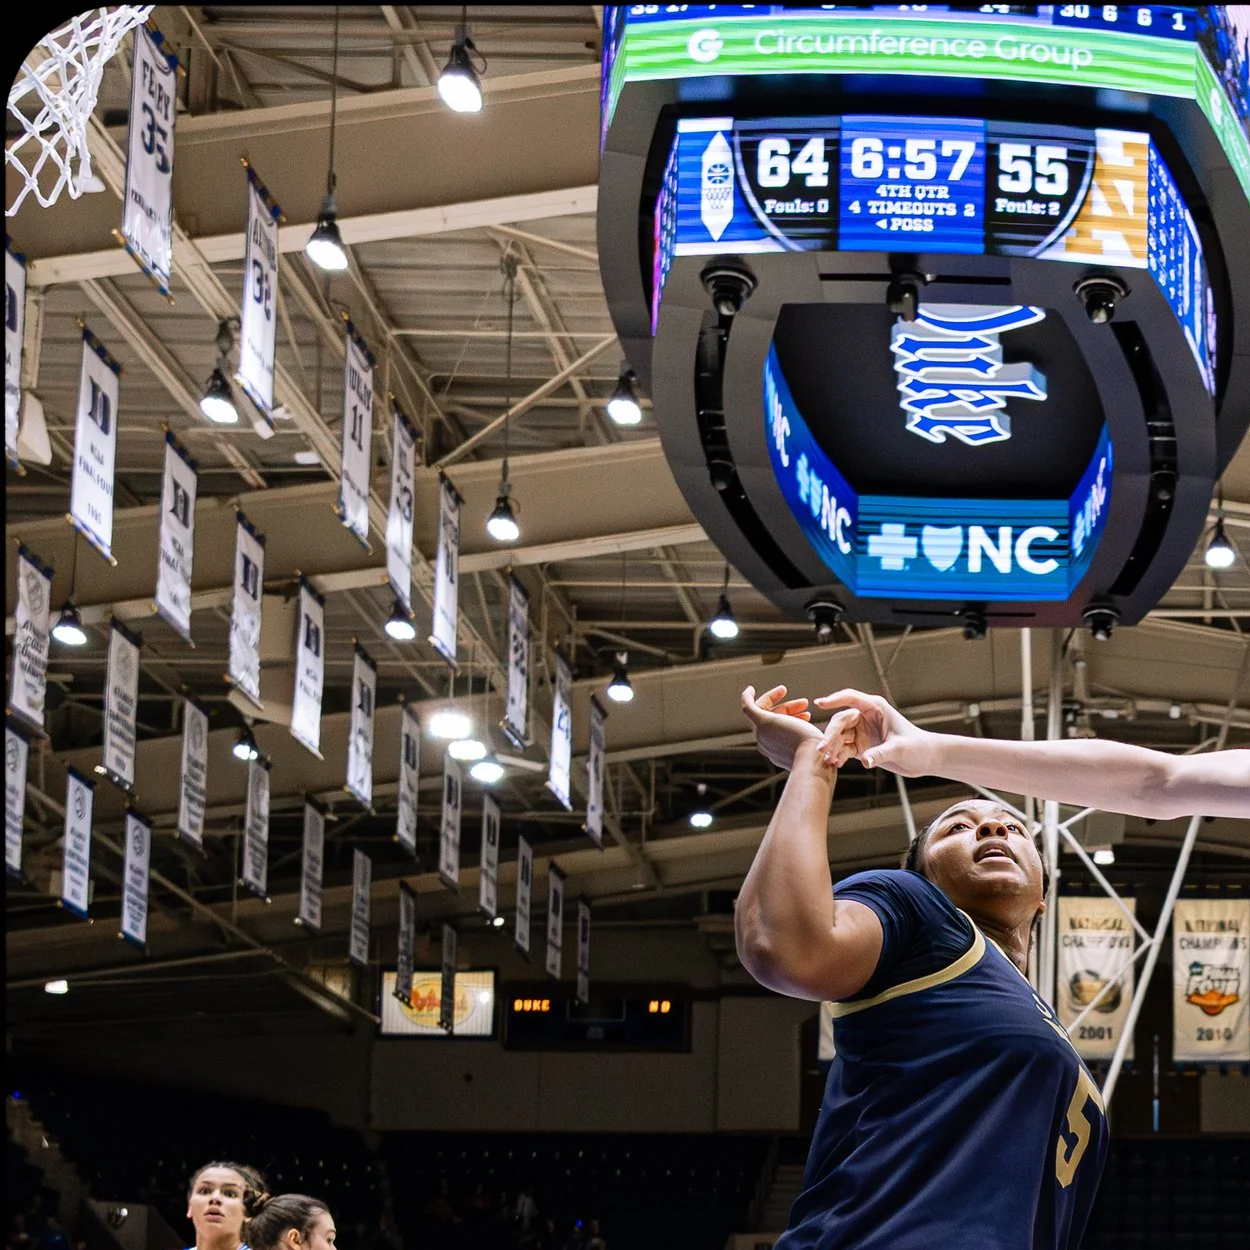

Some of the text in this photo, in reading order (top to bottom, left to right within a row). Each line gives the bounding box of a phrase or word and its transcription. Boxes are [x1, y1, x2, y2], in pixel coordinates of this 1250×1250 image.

[1172, 12, 1186, 31] 1
[754, 29, 984, 58] Circumference
[1000, 34, 1093, 71] Group
[141, 101, 171, 175] 35
[757, 137, 830, 188] 64
[851, 137, 976, 181] 6:57
[998, 143, 1069, 196] 55
[764, 198, 815, 214] Fouls:
[876, 184, 950, 200] 4TH QTR
[995, 198, 1060, 216] Fouls: 2
[848, 200, 976, 217] 4 TIMEOUTS 2
[889, 217, 934, 232] POSS
[821, 484, 852, 555] NC
[967, 525, 1060, 576] NC
[512, 998, 551, 1013] DUKE
[1078, 1025, 1114, 1041] 2001
[1055, 1063, 1105, 1189] 5
